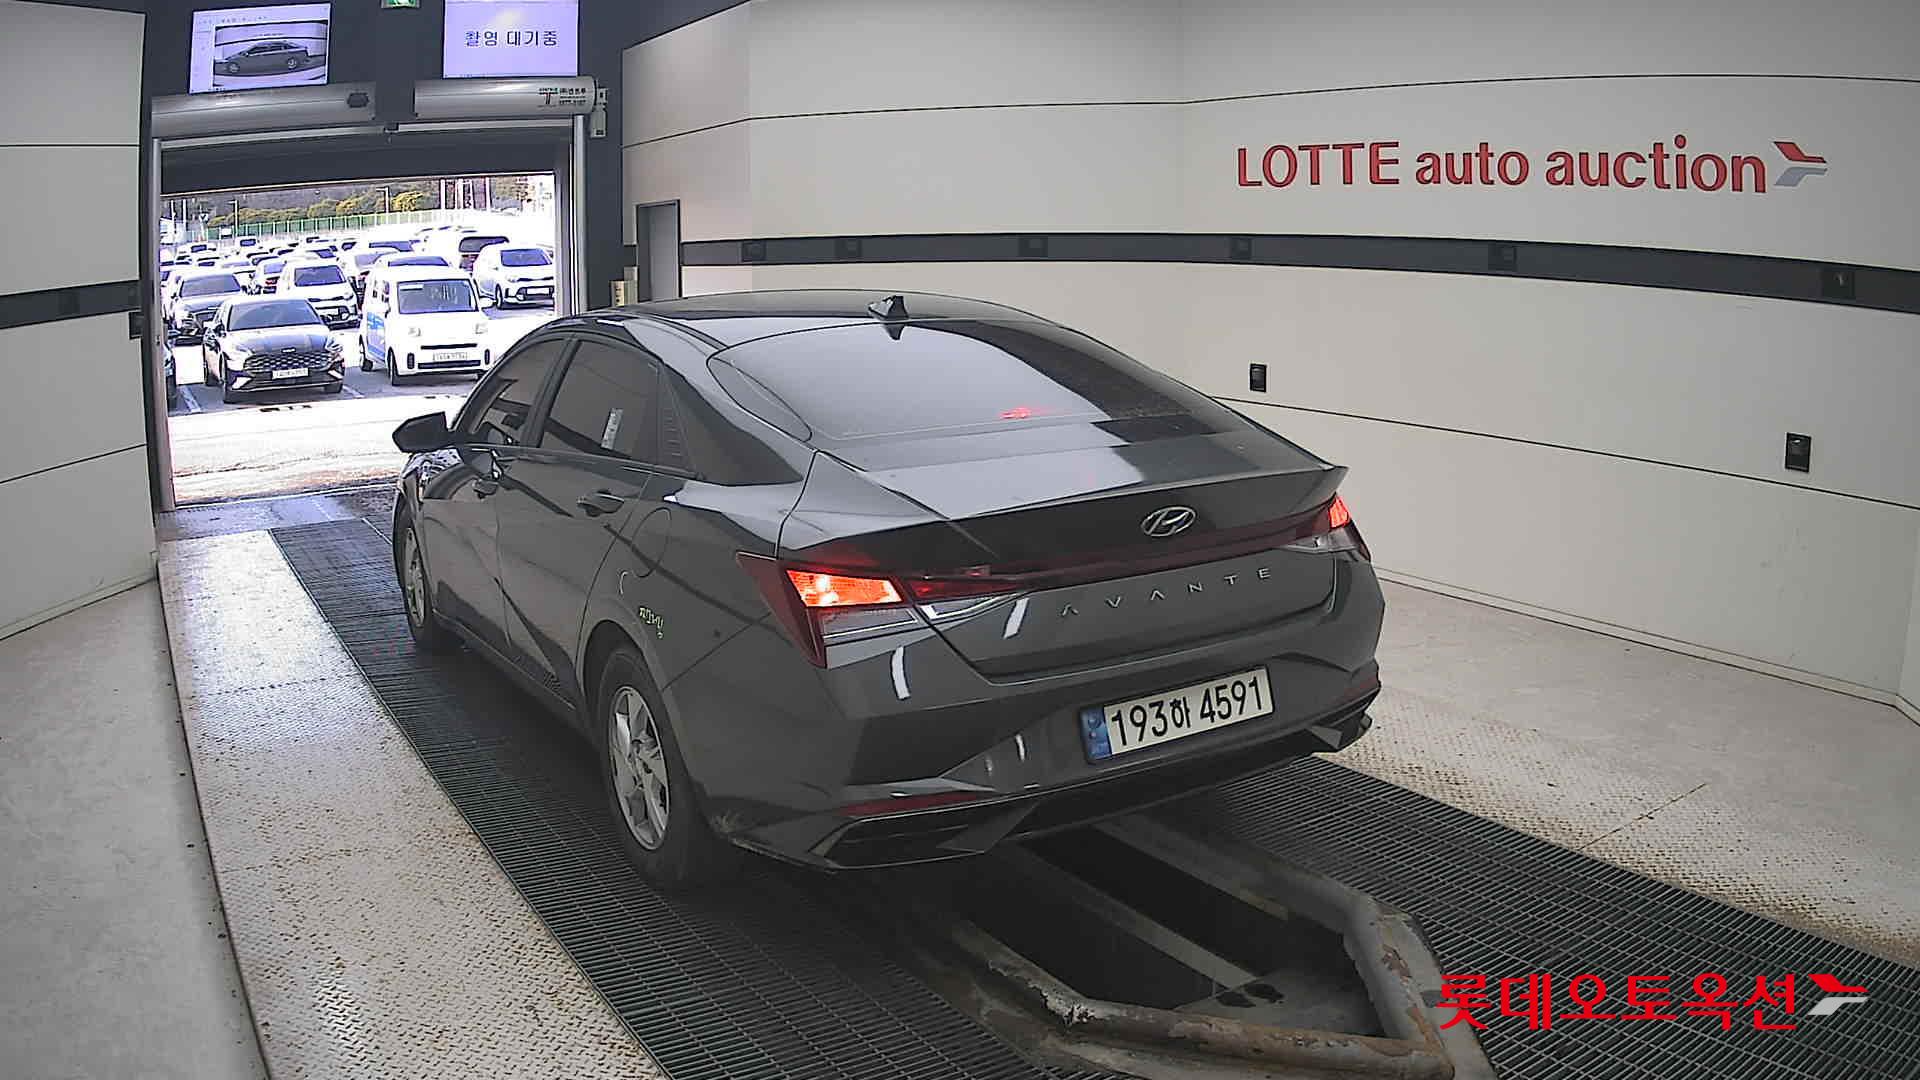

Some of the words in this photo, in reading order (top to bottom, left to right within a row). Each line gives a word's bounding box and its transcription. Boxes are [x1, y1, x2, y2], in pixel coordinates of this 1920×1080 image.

[507, 31, 557, 46] 대기중
[1238, 142, 1400, 188] LOTTE
[1416, 143, 1531, 186] auto
[1546, 134, 1767, 194] auction
[1061, 568, 1272, 616] AVANTE
[1111, 695, 1191, 746] 193하
[1200, 676, 1263, 724] 4591
